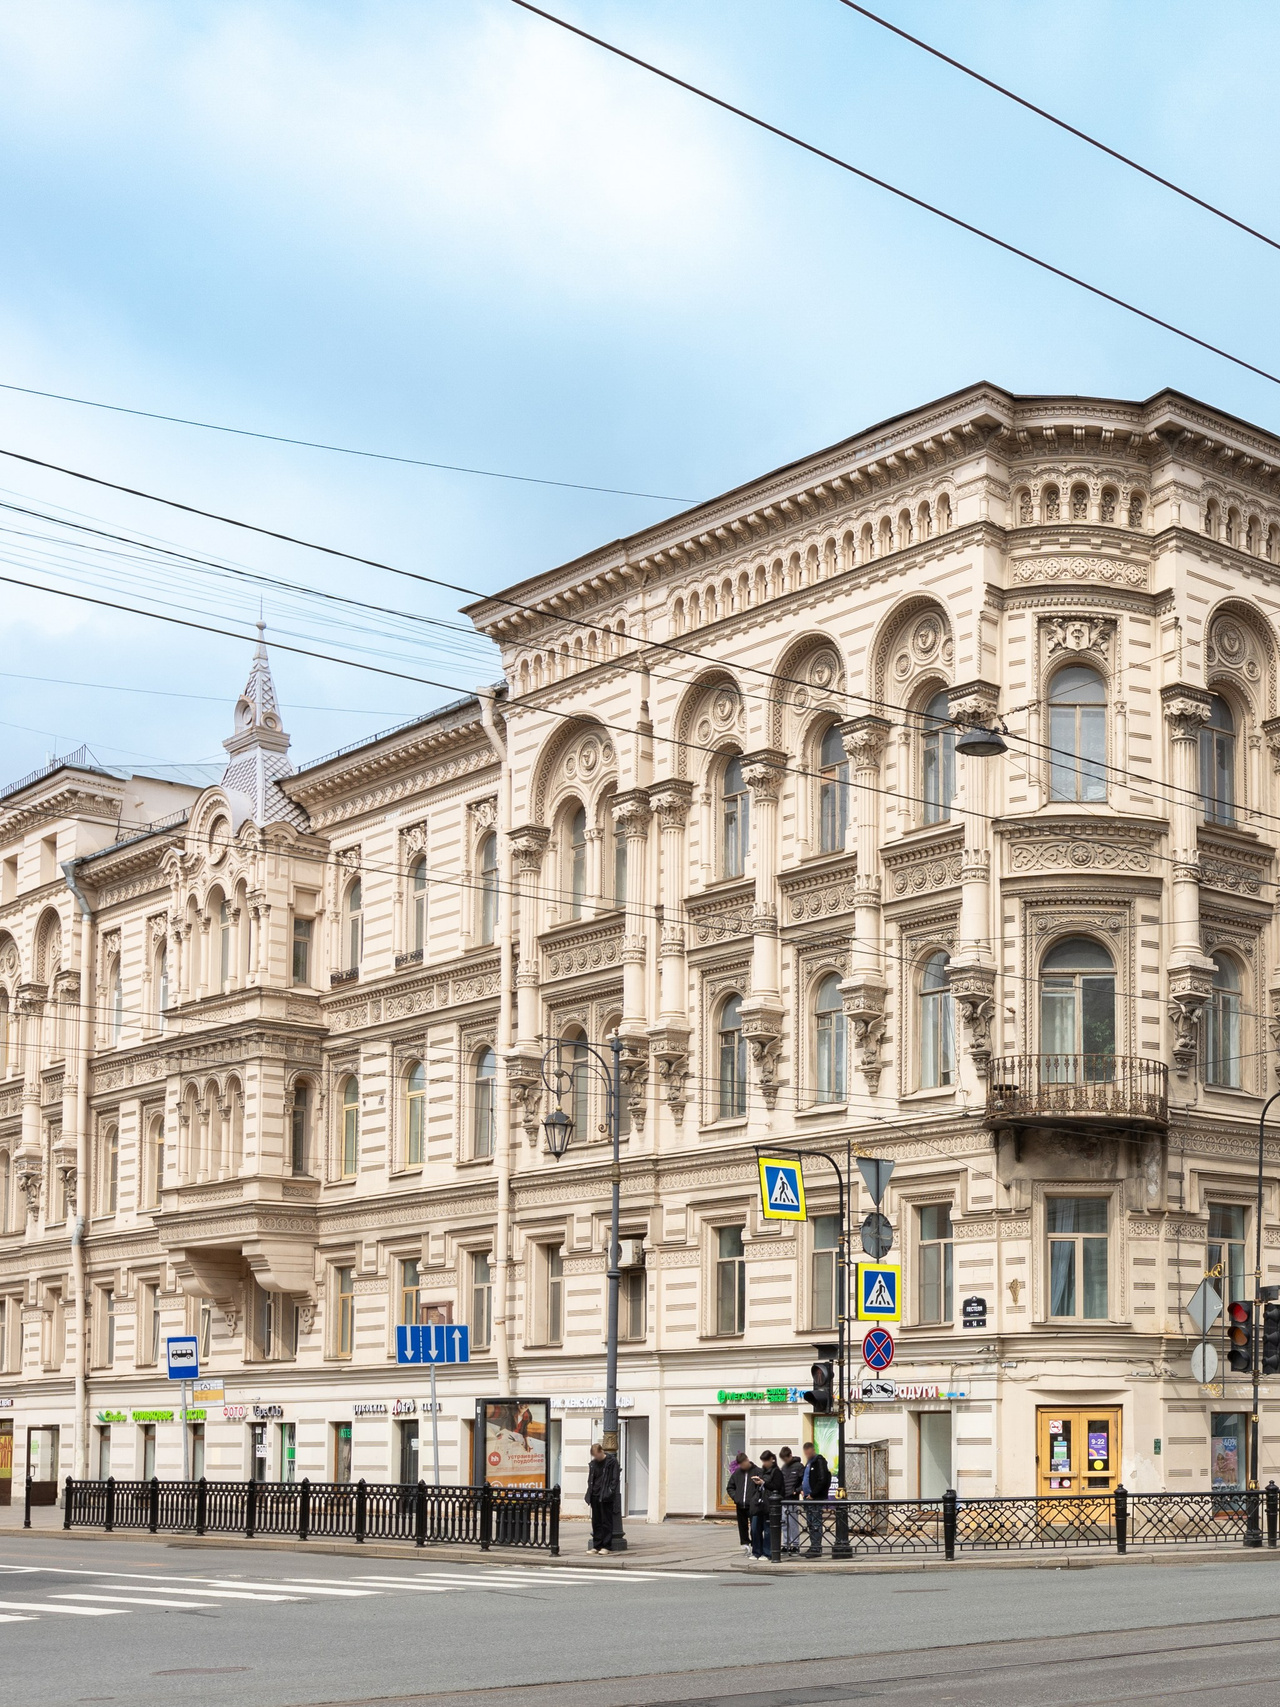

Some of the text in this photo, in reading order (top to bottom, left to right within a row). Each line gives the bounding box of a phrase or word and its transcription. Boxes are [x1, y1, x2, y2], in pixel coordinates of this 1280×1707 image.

[727, 1391, 765, 1401] МЕГАФОН
[223, 1406, 244, 1417] ФОТО
[507, 1453, 545, 1461] устраивайся
